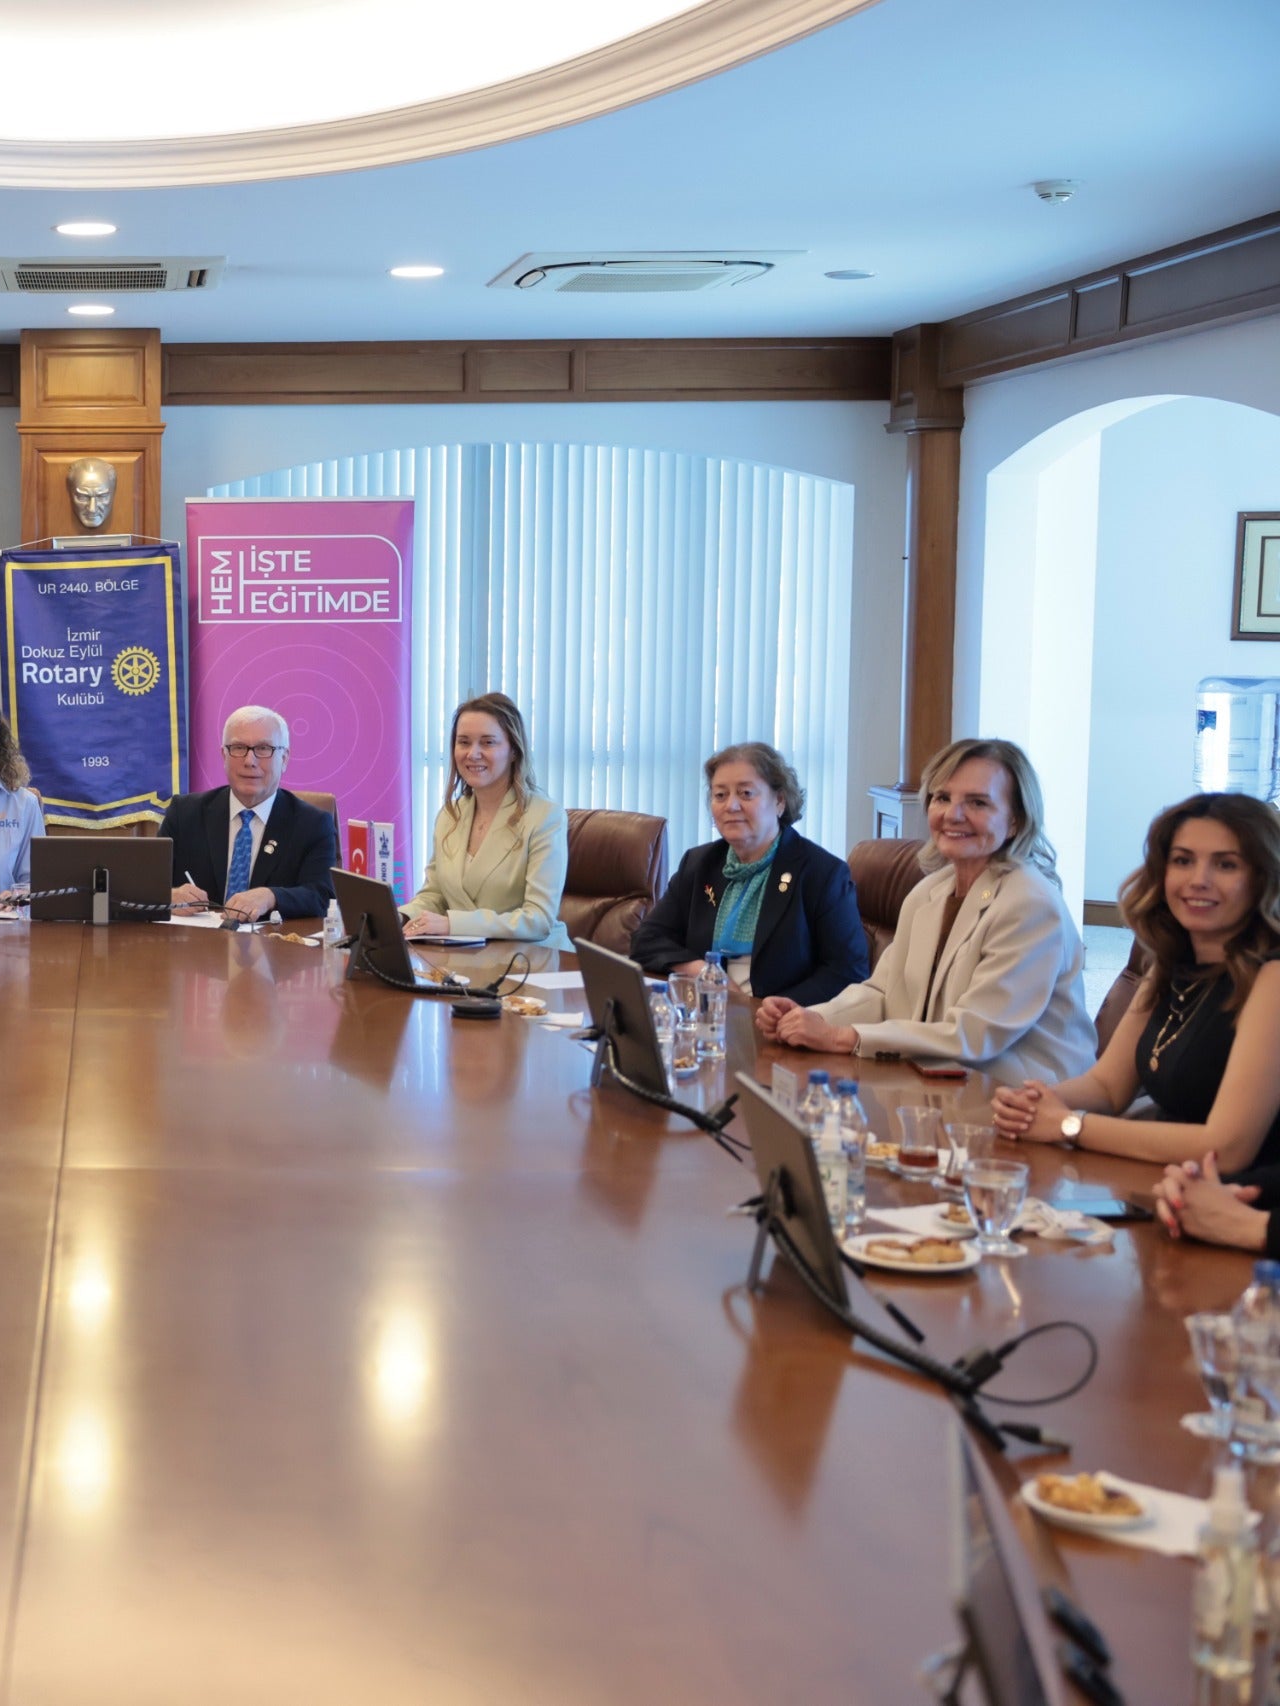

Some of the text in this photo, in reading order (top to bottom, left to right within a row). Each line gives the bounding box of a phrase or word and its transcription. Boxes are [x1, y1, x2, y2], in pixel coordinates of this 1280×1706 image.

[251, 545, 311, 578] İŞTE
[38, 579, 139, 594] UR 2440. BÖLGE
[210, 551, 232, 614] HEM
[251, 585, 390, 614] EĞİTİMDE
[67, 627, 101, 642] İzmir
[21, 644, 103, 660] Dokuz Eylül
[22, 662, 103, 688] Rotary
[57, 692, 105, 706] Kulübü
[81, 756, 110, 768] 1993
